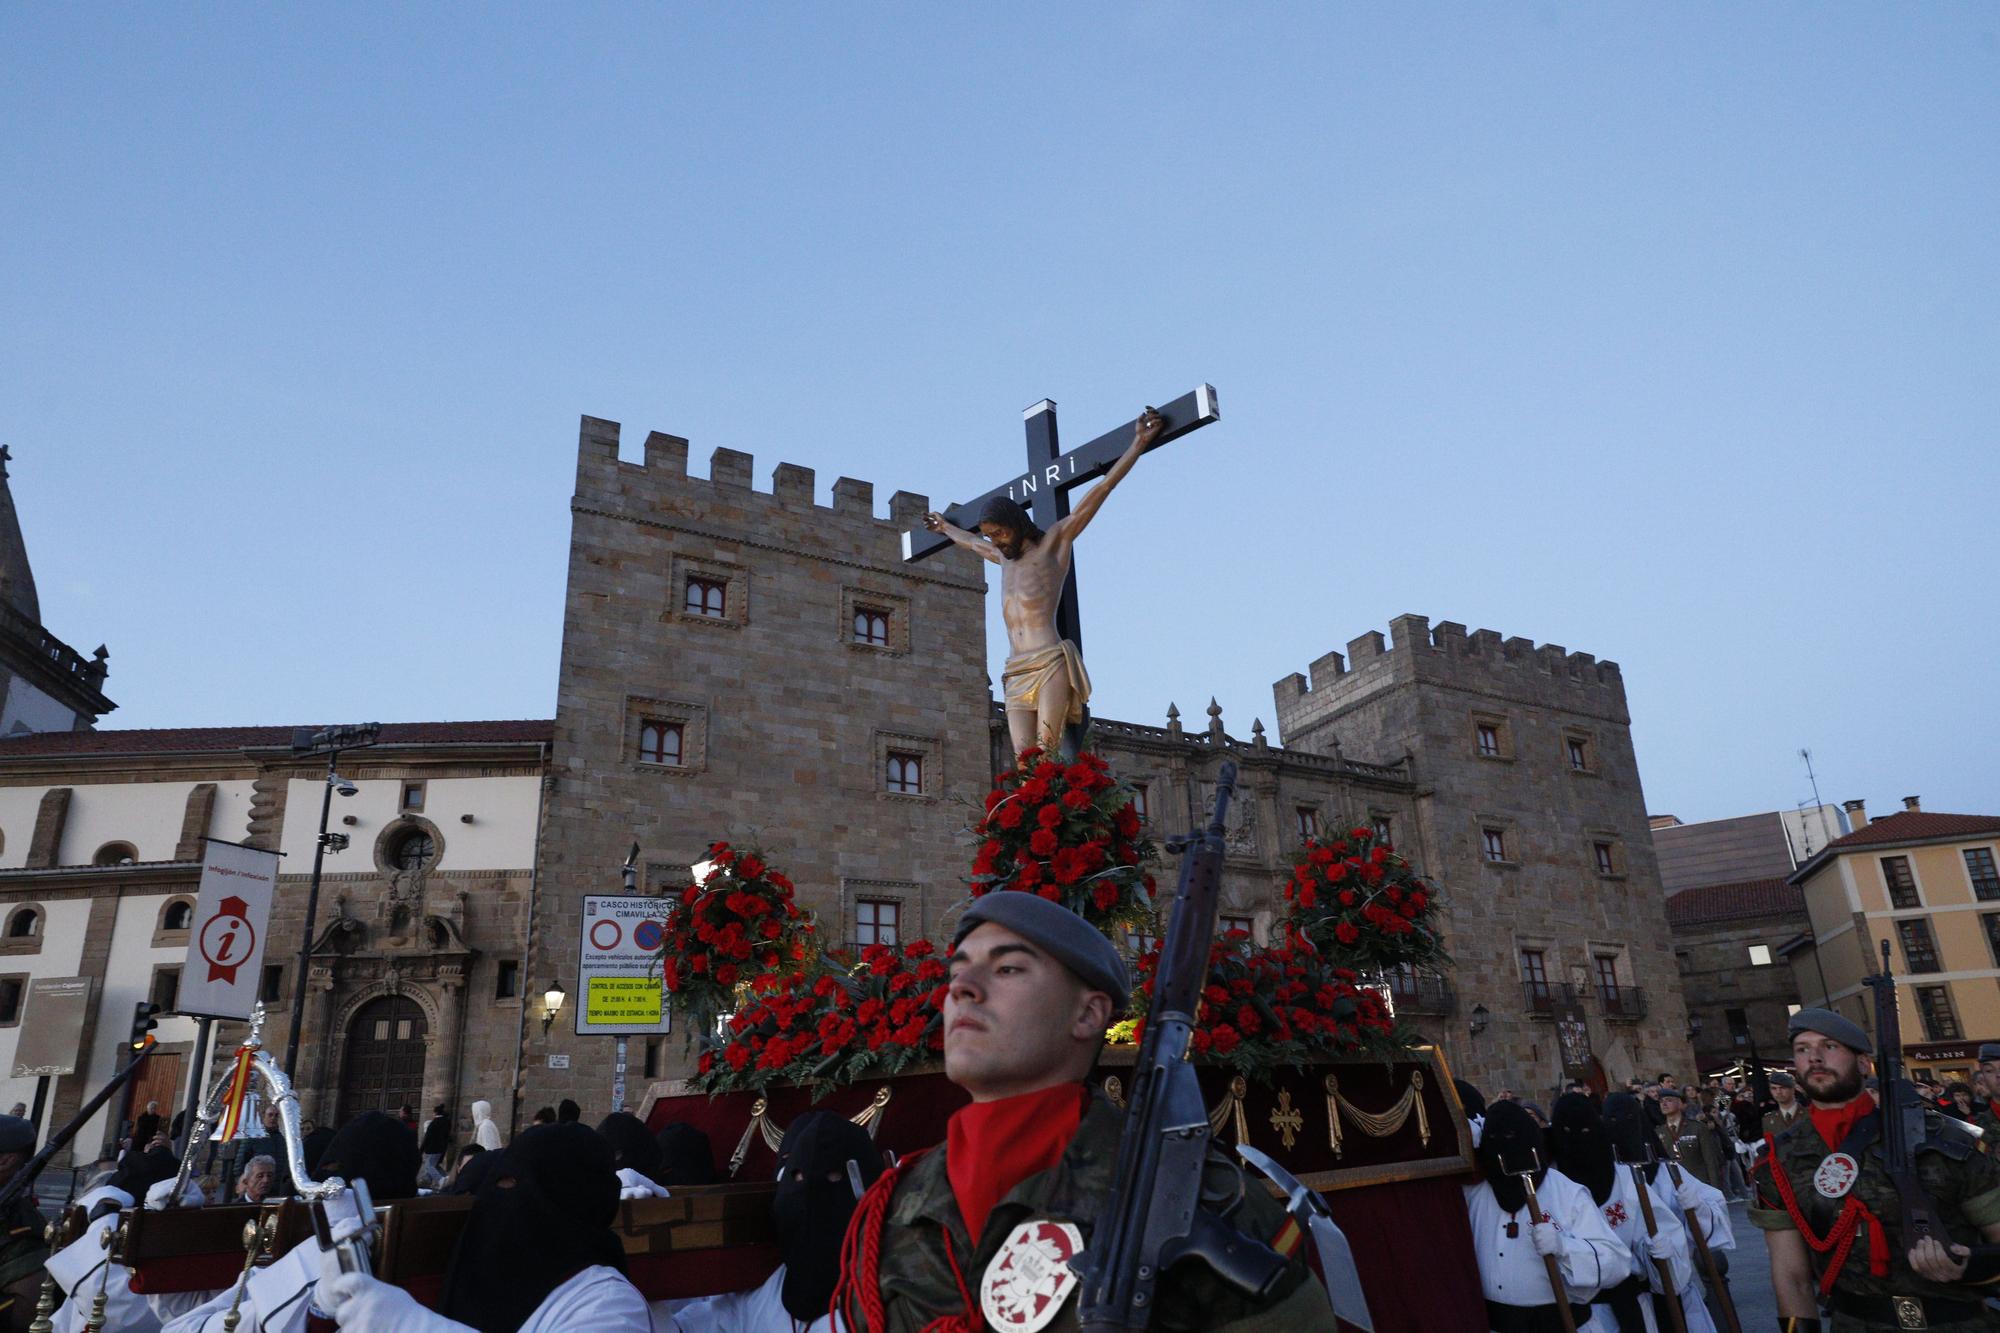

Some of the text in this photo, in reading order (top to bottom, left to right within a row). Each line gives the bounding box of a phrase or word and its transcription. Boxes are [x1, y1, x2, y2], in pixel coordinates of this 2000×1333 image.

[600, 901, 629, 909] CASCO
[615, 911, 657, 919] CIMAVILLA
[619, 962, 638, 970] público
